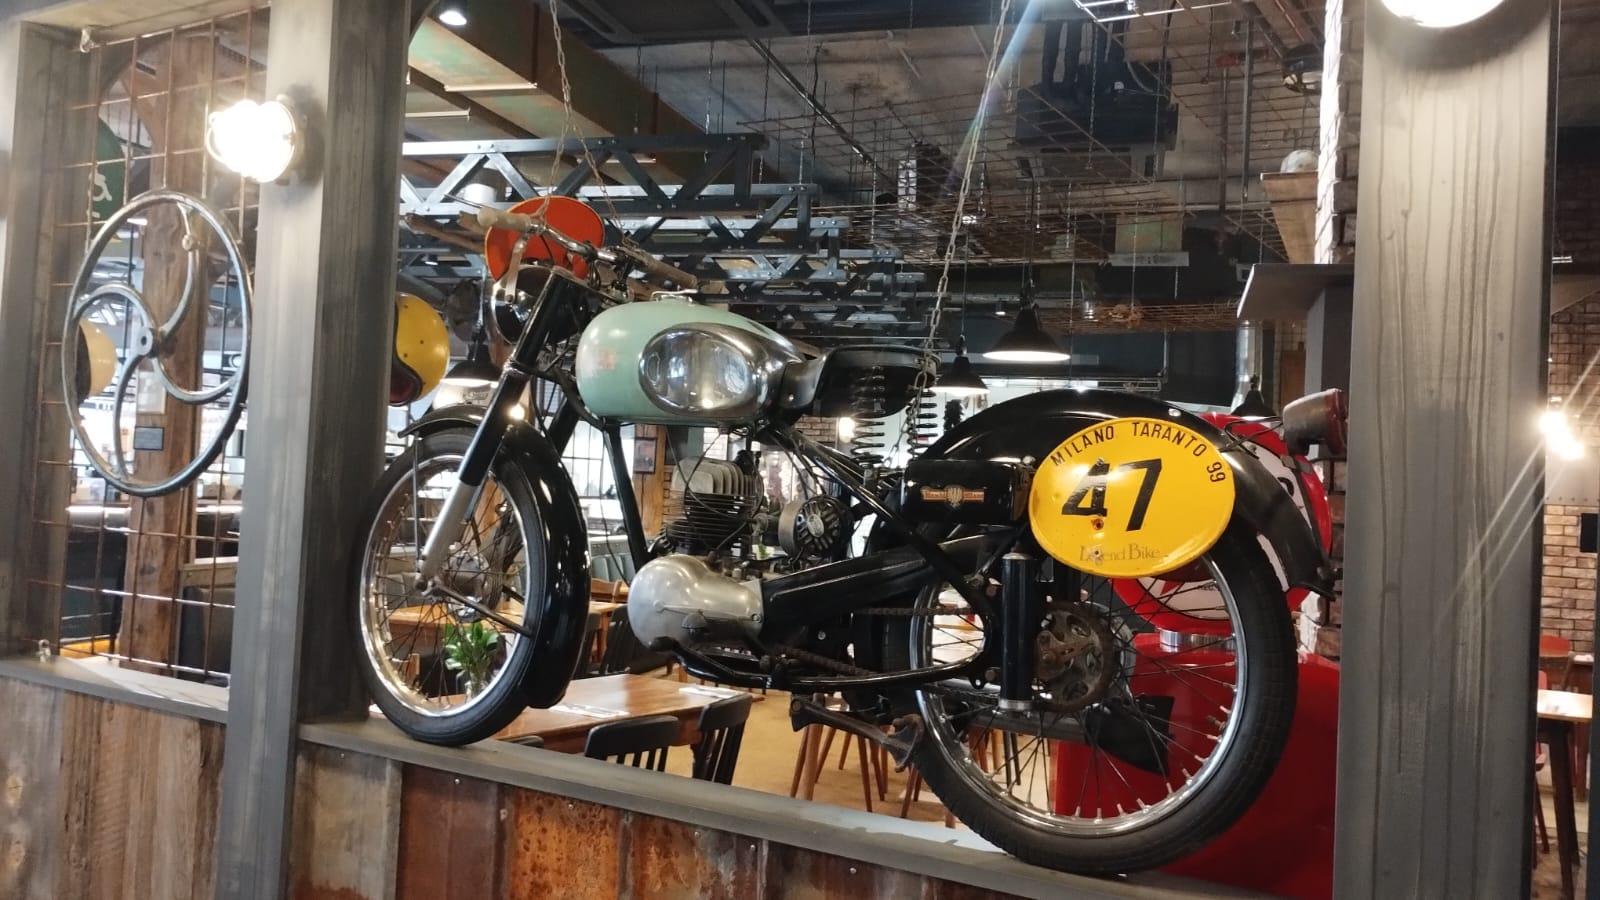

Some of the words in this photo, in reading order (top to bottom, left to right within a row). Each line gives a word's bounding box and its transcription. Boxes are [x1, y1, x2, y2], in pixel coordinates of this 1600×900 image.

[1050, 425, 1114, 466] MILANO
[1132, 422, 1207, 457] TARANTO
[1207, 461, 1226, 482] 99
[1061, 458, 1162, 532] 47
[1128, 543, 1160, 560] Bike
